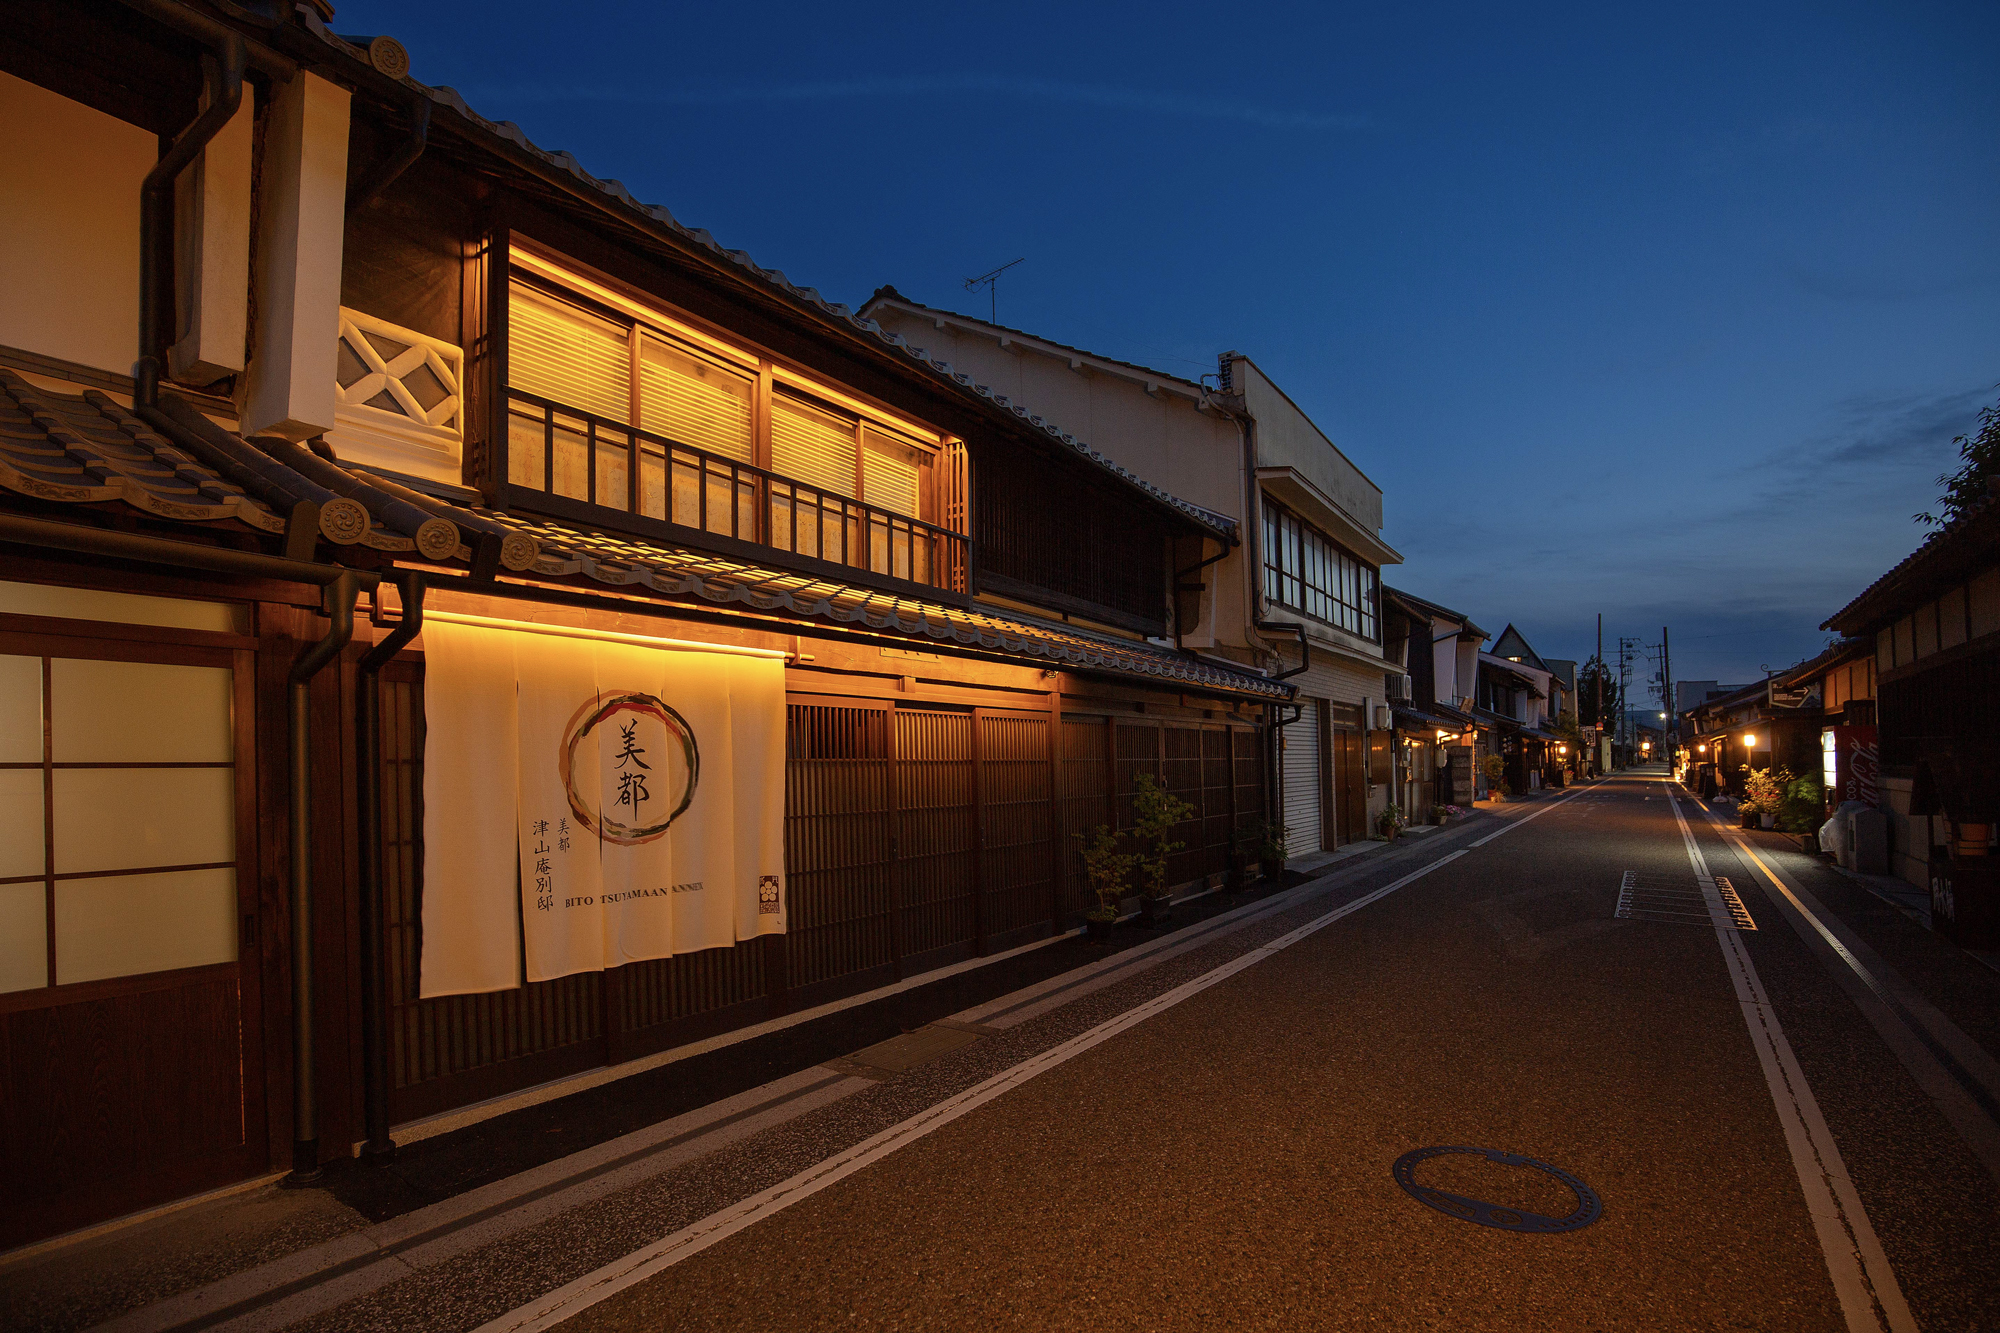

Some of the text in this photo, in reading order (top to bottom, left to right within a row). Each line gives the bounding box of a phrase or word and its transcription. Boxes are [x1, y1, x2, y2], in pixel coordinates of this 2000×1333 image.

[614, 718, 652, 821] 美都
[533, 819, 555, 912] 津山庵別邸
[557, 817, 571, 853] 美都
[565, 896, 594, 909] BITO
[600, 887, 668, 904] TSUYAMAAN
